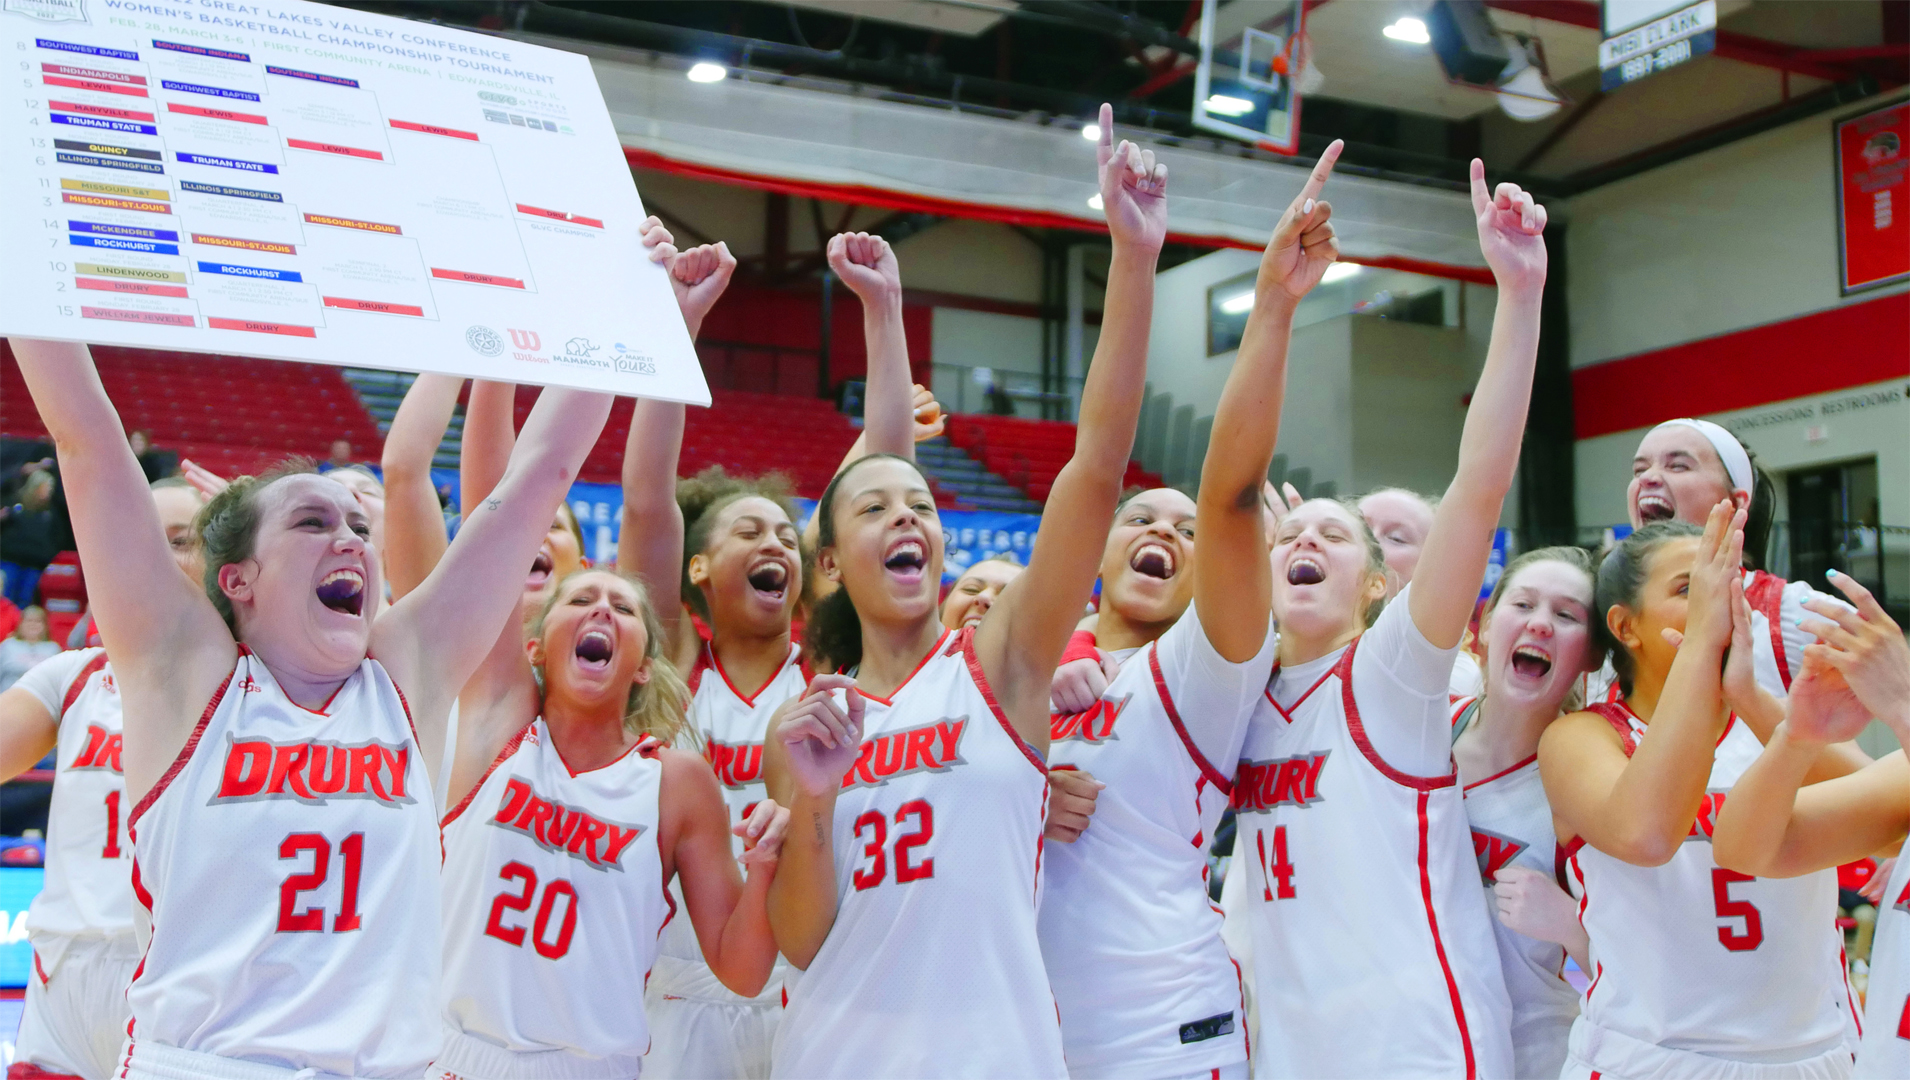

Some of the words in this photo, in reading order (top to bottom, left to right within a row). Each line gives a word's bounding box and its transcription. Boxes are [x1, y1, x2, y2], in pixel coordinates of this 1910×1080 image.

[201, 0, 260, 16] GREAT
[267, 10, 323, 28] LAKES
[329, 19, 394, 39] VALLEY
[401, 33, 512, 62] CONFERENCE
[17, 41, 26, 51] 8
[105, 0, 193, 20] WOMEN'S
[199, 13, 313, 40] BASKETBALL
[317, 33, 442, 63] CHAMPIONSHIP
[447, 56, 555, 85] TOURNAMENT
[109, 17, 140, 28] FEB.
[169, 26, 218, 40] MARCH
[263, 41, 300, 54] FIRST
[304, 48, 382, 68] COMMUNITY
[387, 61, 431, 76] ARENA
[39, 40, 98, 54] SOUTHWEST
[100, 47, 137, 59] BAPTIST
[155, 40, 207, 54] SOUTHERN
[208, 48, 248, 60] INDIANA
[20, 61, 30, 71] 9
[59, 66, 130, 82] INDIANAPOLIS
[269, 66, 317, 81] SOUTHERN
[319, 74, 356, 86] INDIANA
[24, 79, 33, 89] 5
[81, 81, 112, 91] LEWIS
[164, 82, 220, 97] SOUTHWEST
[222, 90, 258, 101] BAPTIST
[23, 99, 39, 109] 12
[74, 104, 130, 116] MARYVILLE
[204, 108, 234, 119] LEWIS
[29, 116, 39, 126] 4
[66, 116, 110, 128] TRUMAN
[112, 122, 142, 132] STATE
[422, 125, 449, 135] LEWIS
[29, 137, 46, 148] 13
[88, 144, 128, 155] QUINCY
[321, 144, 350, 155] LEWIS
[36, 155, 46, 166] 6
[58, 154, 99, 165] ILLINOIS
[101, 159, 161, 172] SPRINGFIELD
[191, 155, 233, 168] TRUMAN
[235, 162, 264, 172] STATE
[38, 177, 50, 188] 11
[81, 182, 130, 195] MISSOURI
[182, 182, 221, 194] ILLINOIS
[223, 187, 280, 200] SPRINGFIELD
[42, 196, 52, 206] 3
[69, 194, 165, 212] MISSOURI-ST.LOUIS
[42, 218, 59, 229] 14
[310, 215, 397, 233] MISSOURI-ST.LOUIS
[92, 224, 155, 237] MCKENDREE
[554, 226, 596, 239] CHAMPION
[49, 238, 58, 248] 7
[94, 238, 156, 251] ROCKHURST
[198, 236, 290, 253] MISSOURI-ST.LOUIS
[49, 261, 67, 272] 10
[96, 267, 169, 279] LINDENWOOD
[221, 265, 280, 278] ROCKHURST
[463, 273, 493, 283] DRURY
[56, 282, 66, 292] 2
[114, 283, 150, 292] DRURY
[56, 305, 74, 316] 15
[358, 302, 390, 311] DRURY
[93, 309, 140, 320] WILLIAM
[143, 313, 183, 324] JEWELL
[246, 322, 279, 332] DRURY
[512, 352, 550, 364] Wilson
[553, 355, 610, 368] MAMMOTH
[625, 354, 645, 362] MAKE
[1821, 389, 1901, 415] RESTROOMS
[1050, 694, 1130, 743] URY
[839, 717, 967, 790] RURY
[212, 735, 414, 805] DRURY
[1233, 751, 1330, 812] DRURY
[102, 790, 121, 859] 1
[490, 776, 645, 869] DRURY
[853, 798, 934, 892] 32
[1257, 825, 1297, 902] 14
[276, 831, 365, 934] 21
[484, 859, 579, 961] 20
[1711, 867, 1764, 952] 5
